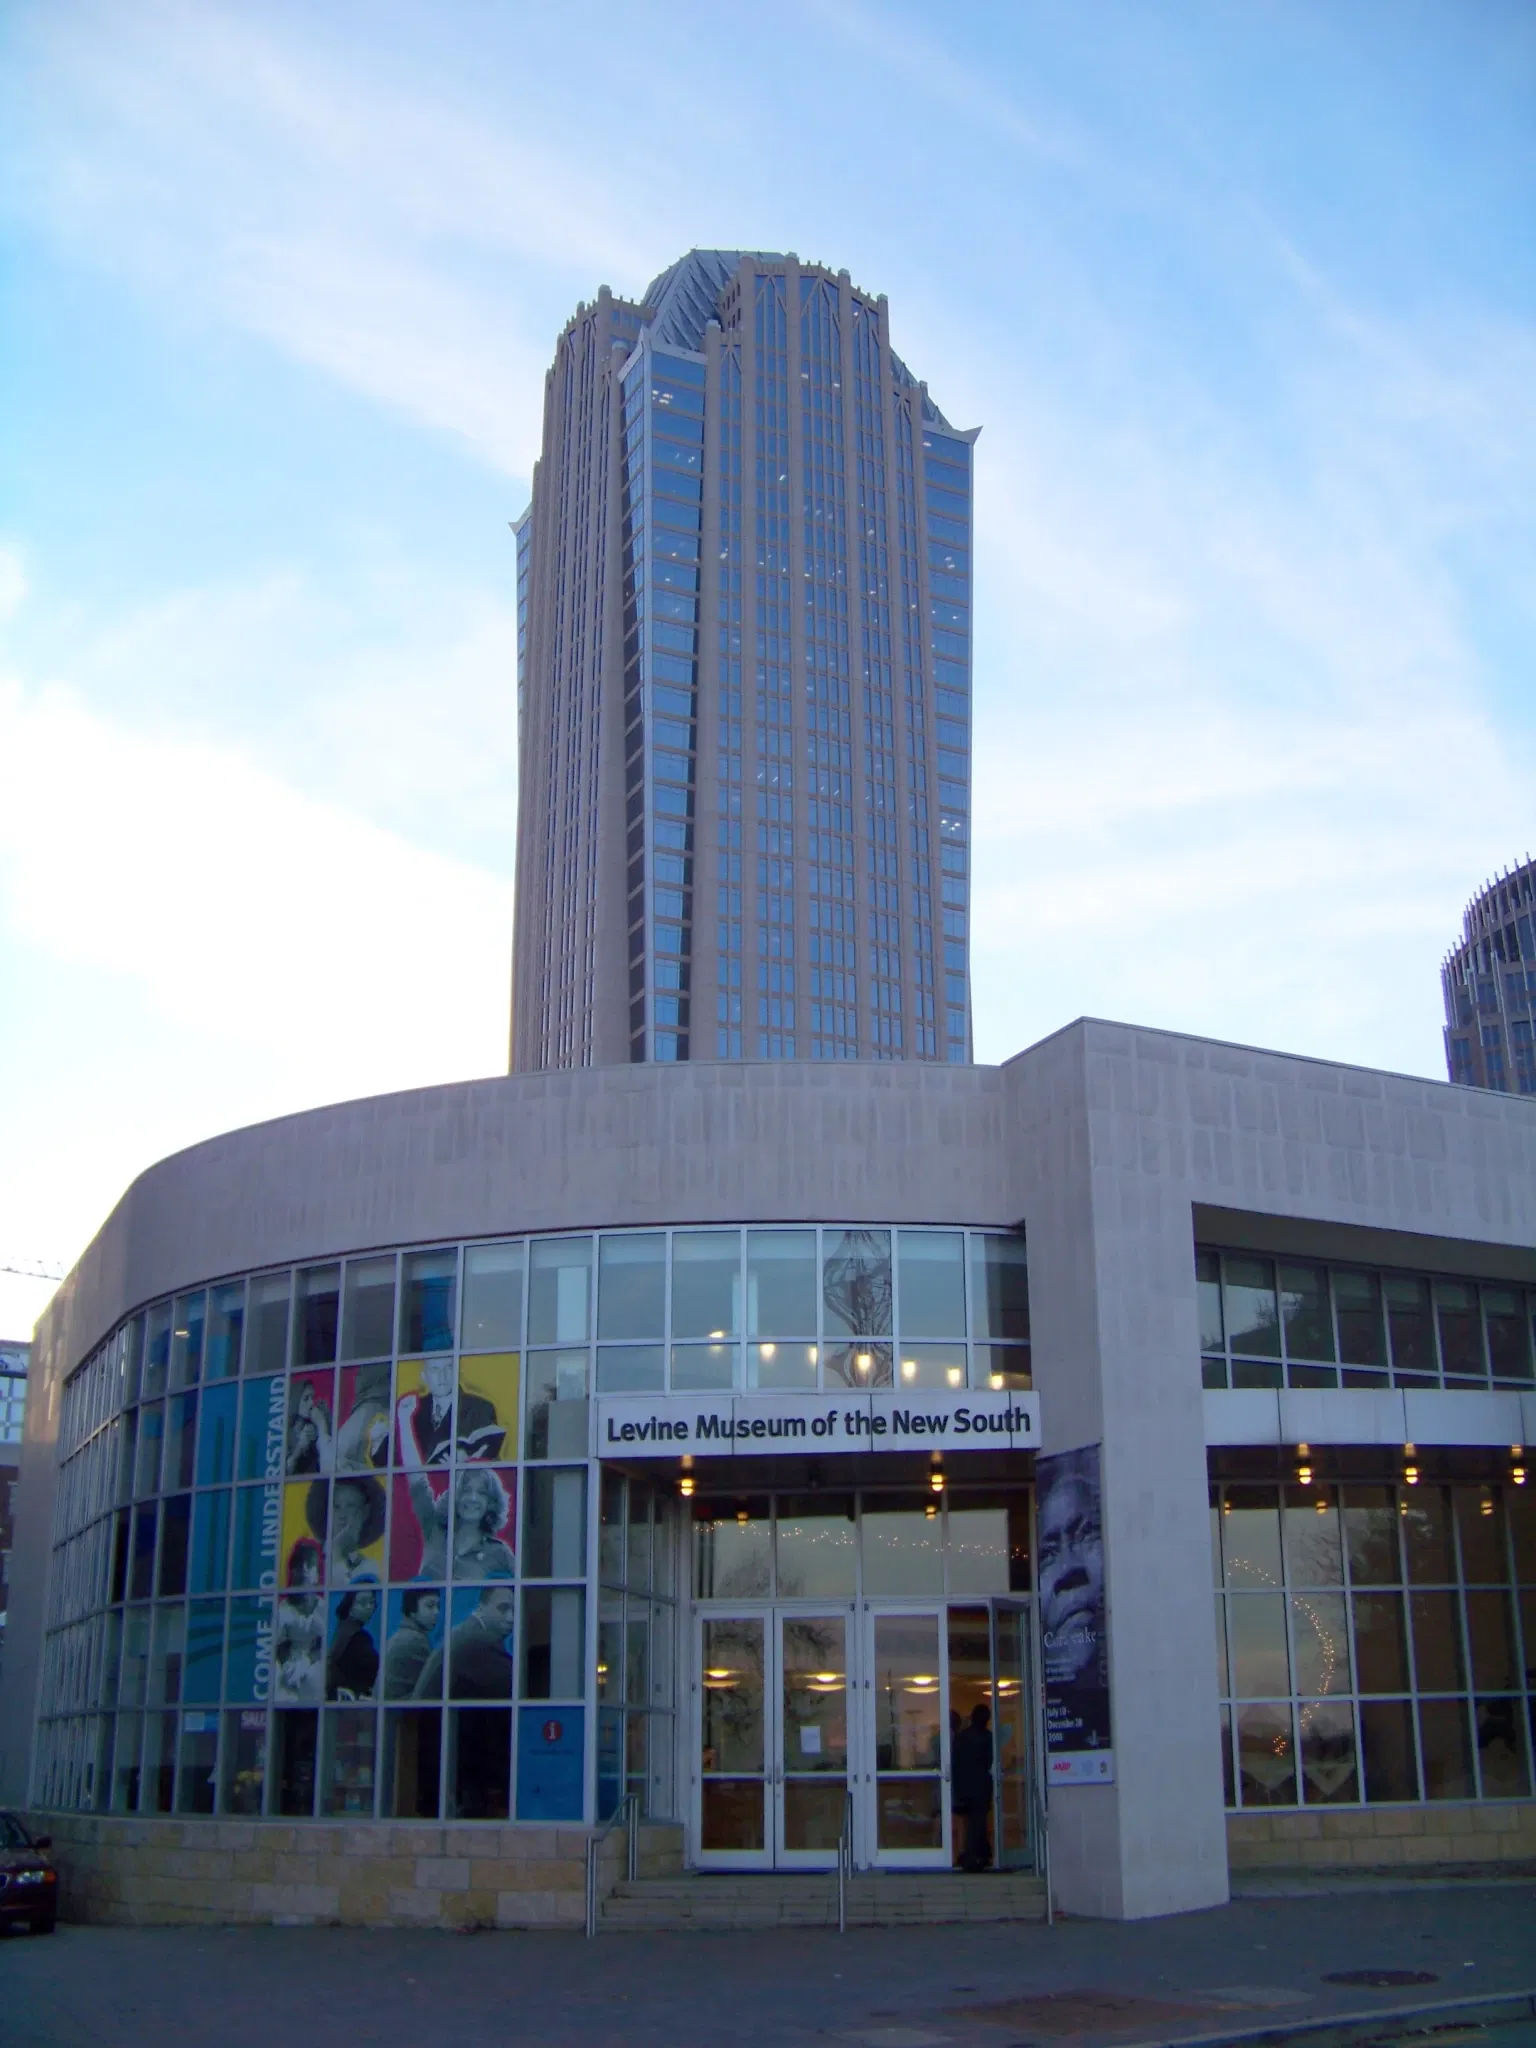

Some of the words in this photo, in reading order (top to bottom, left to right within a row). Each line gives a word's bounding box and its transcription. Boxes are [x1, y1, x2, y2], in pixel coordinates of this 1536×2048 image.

[607, 1416, 689, 1442] Levine
[695, 1414, 806, 1439] Museum
[811, 1409, 838, 1436] of
[843, 1409, 888, 1436] the
[892, 1409, 949, 1435] New
[953, 1406, 1031, 1433] South
[261, 1376, 286, 1556] UNDERSTAND
[258, 1569, 276, 1608] TO
[253, 1619, 273, 1700] COME
